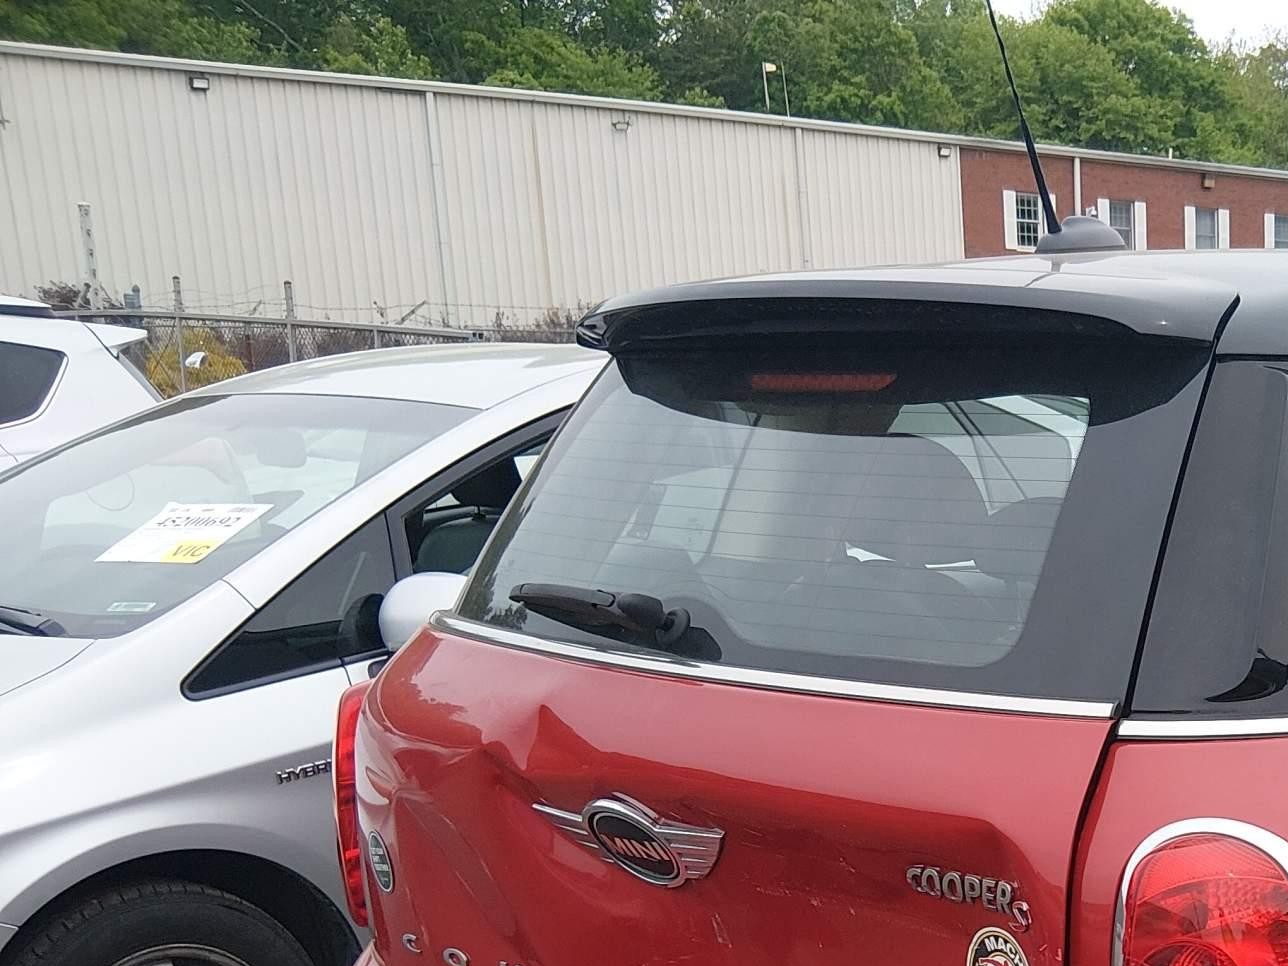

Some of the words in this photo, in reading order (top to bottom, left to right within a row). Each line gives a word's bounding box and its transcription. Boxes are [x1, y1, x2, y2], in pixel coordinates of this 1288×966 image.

[599, 833, 671, 861] MINI
[905, 864, 1013, 916] COOPER
[1007, 900, 1032, 931] S
